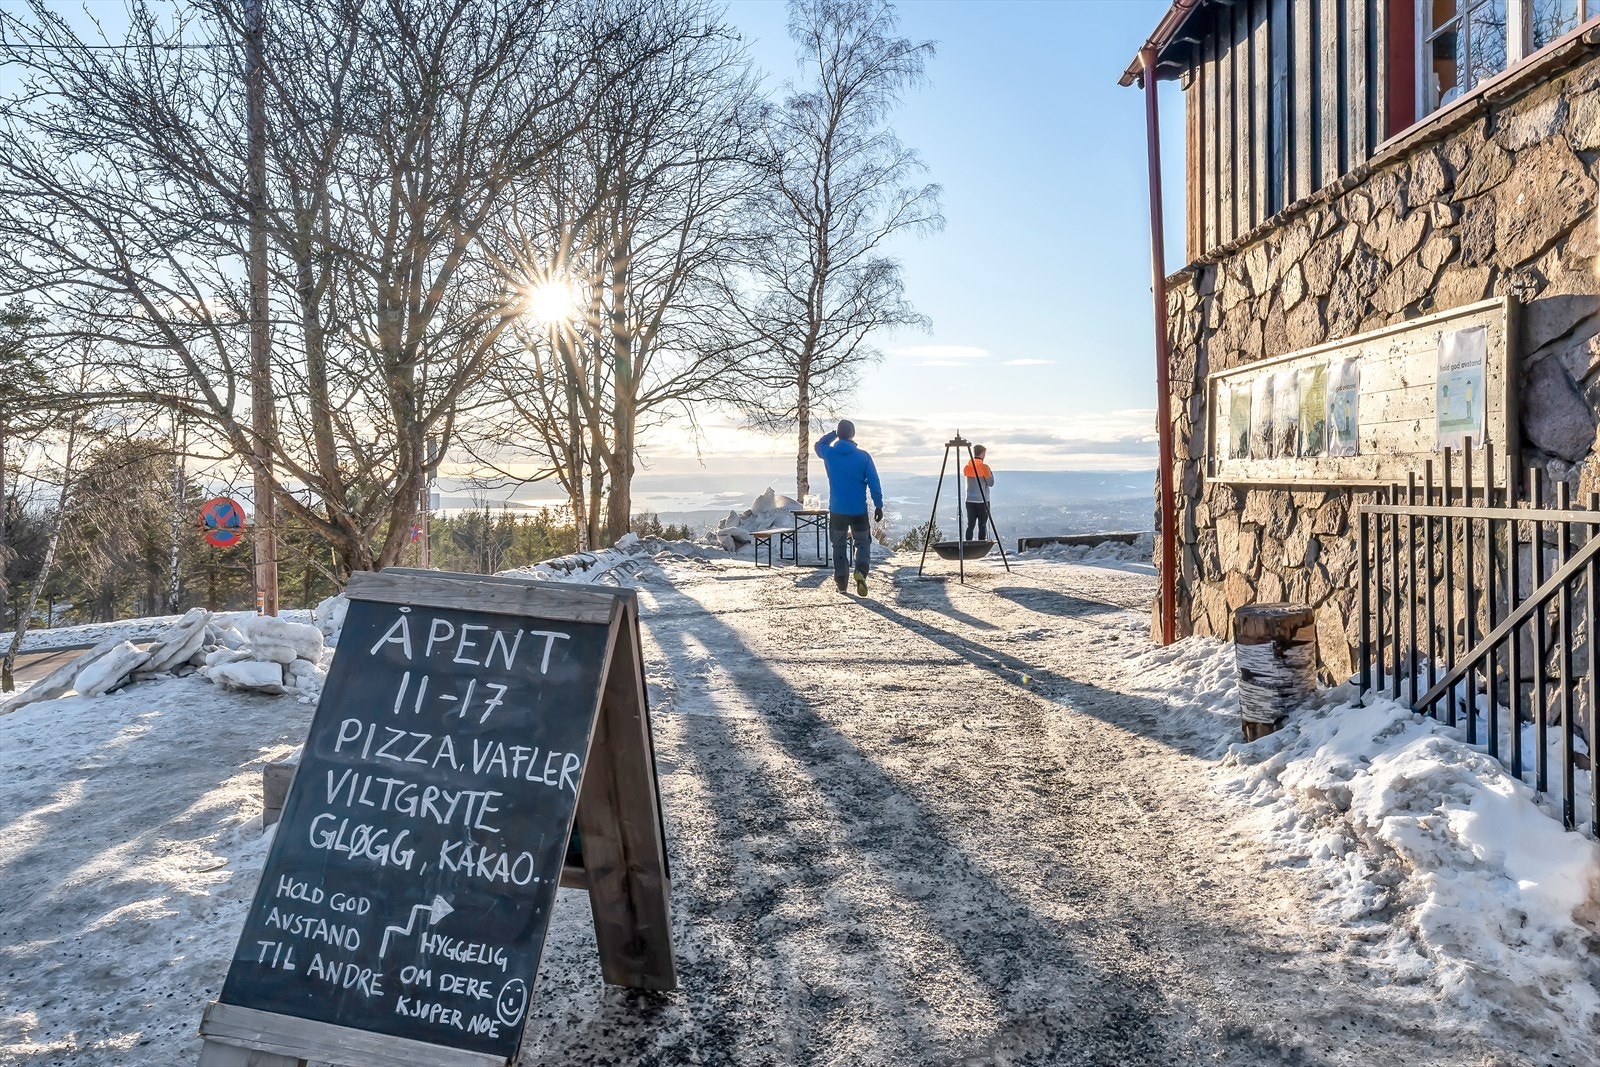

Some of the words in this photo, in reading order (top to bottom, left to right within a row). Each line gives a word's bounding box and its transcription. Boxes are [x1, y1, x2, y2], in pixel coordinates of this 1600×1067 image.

[370, 606, 571, 675] ÅPENT
[394, 671, 508, 724] 11-17
[334, 718, 466, 772] PIZZA,
[473, 738, 581, 800] VAFLER
[327, 768, 503, 833] VILTGRYTE
[276, 874, 324, 904] HOLD
[330, 893, 370, 915] GOD
[265, 907, 360, 951] AVSTAND
[420, 932, 508, 972] HYGGELIG
[257, 940, 296, 970] TIL
[306, 952, 384, 998] ANDRE
[400, 966, 432, 987] OM
[439, 973, 493, 1001] DERE
